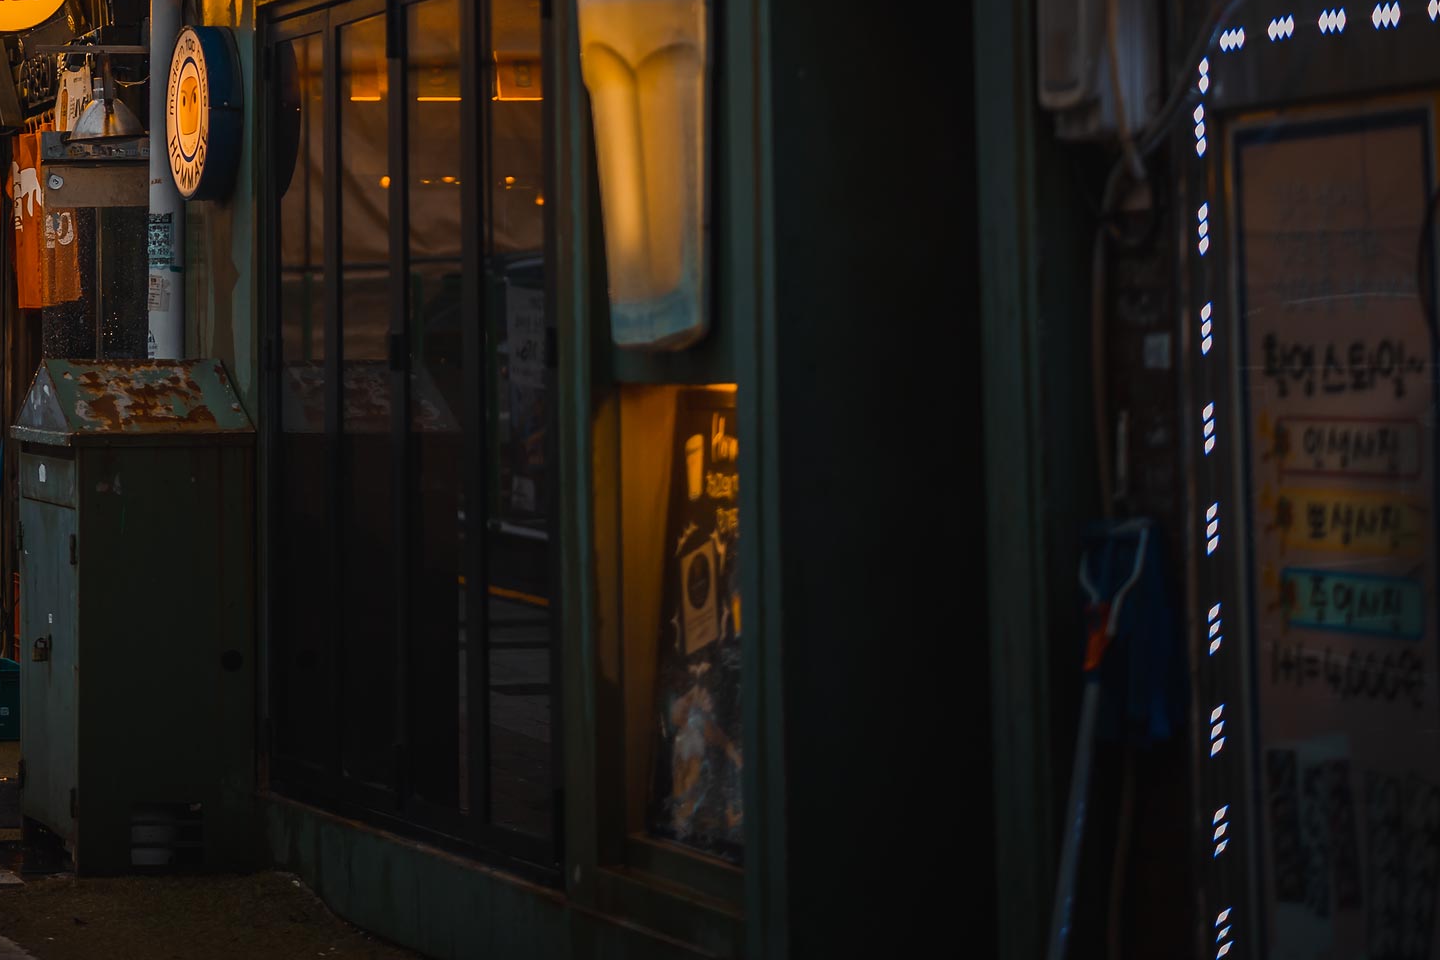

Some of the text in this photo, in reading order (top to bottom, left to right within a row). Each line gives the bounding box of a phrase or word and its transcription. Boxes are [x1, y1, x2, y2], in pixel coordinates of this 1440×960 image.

[169, 46, 186, 116] modern
[185, 36, 196, 53] tap
[170, 130, 209, 191] HOMMAGE
